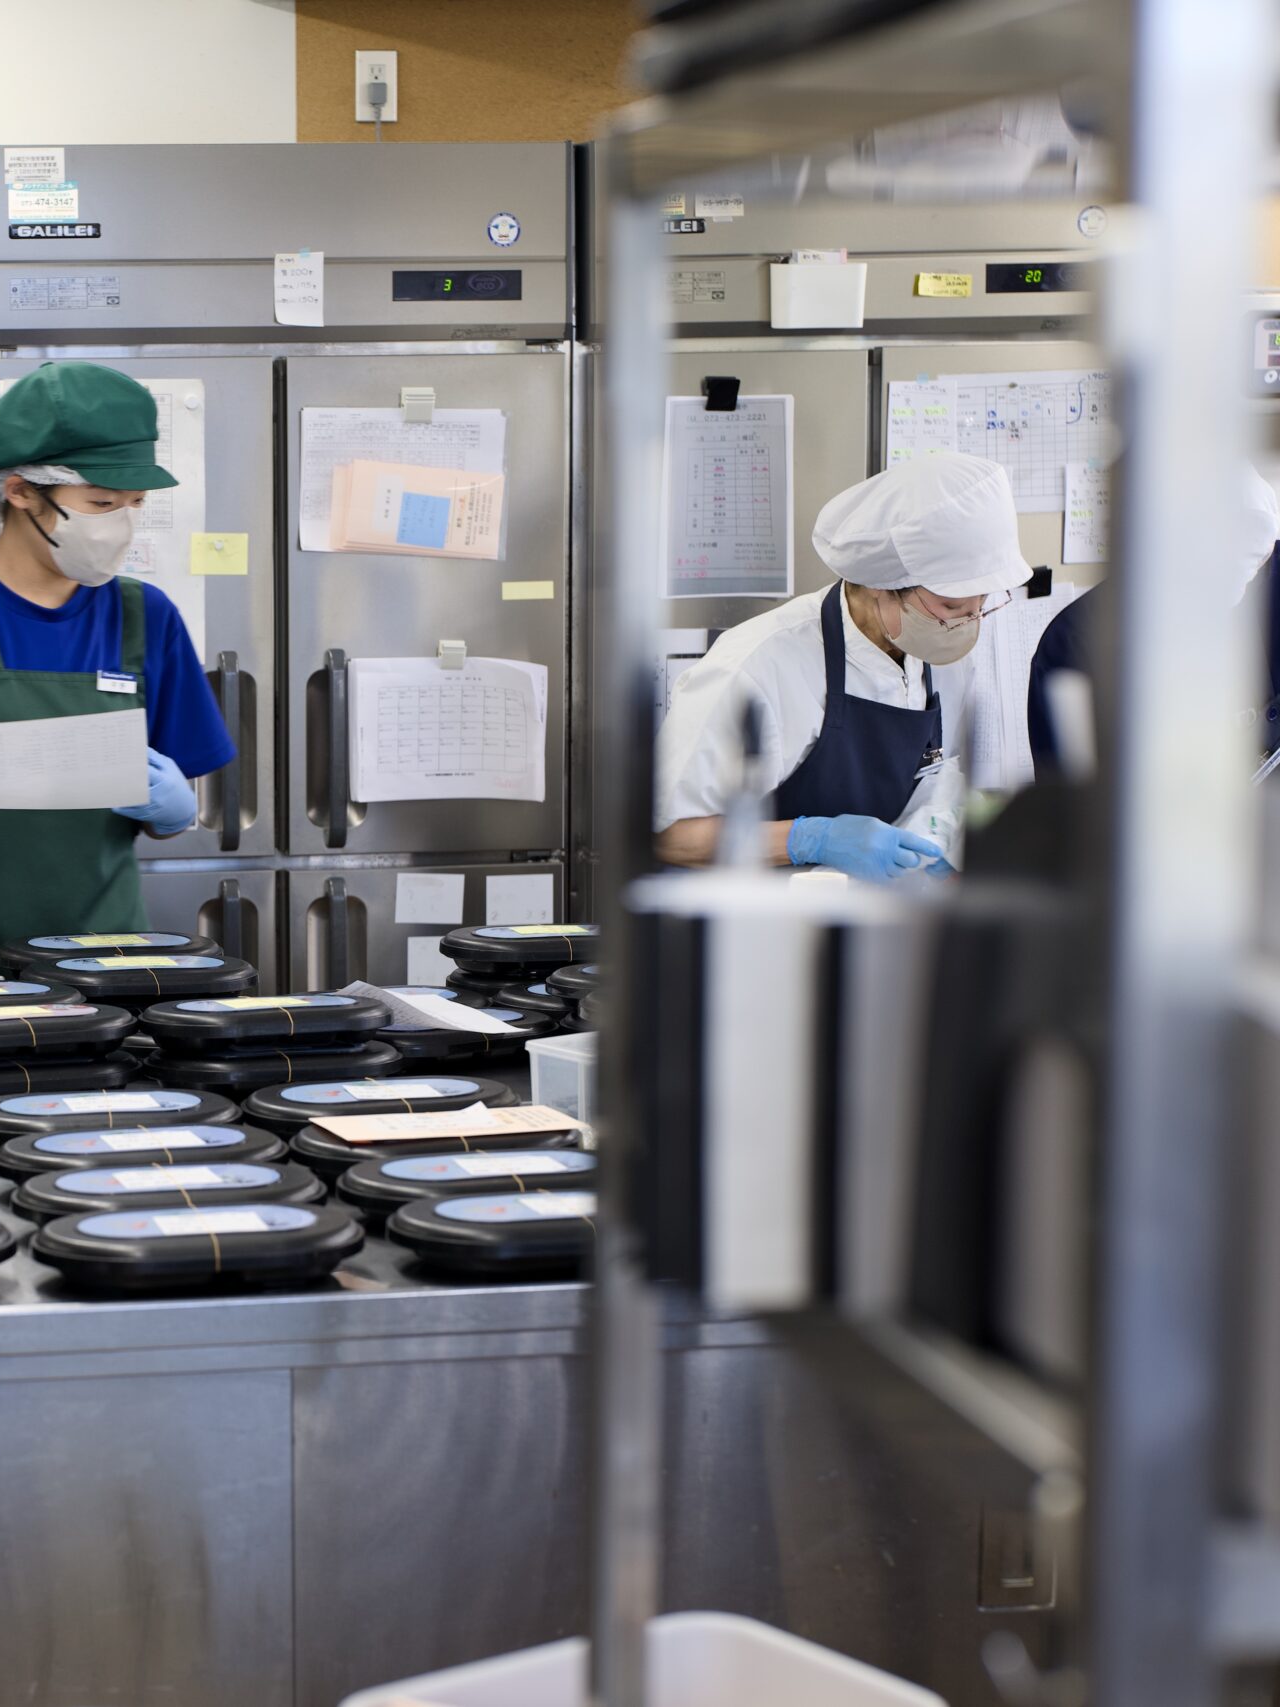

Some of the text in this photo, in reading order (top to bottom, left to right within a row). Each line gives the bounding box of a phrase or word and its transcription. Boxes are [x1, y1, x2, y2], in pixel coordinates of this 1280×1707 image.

[17, 225, 93, 236] GALILEI
[1025, 270, 1041, 282] 20
[443, 279, 452, 291] 3
